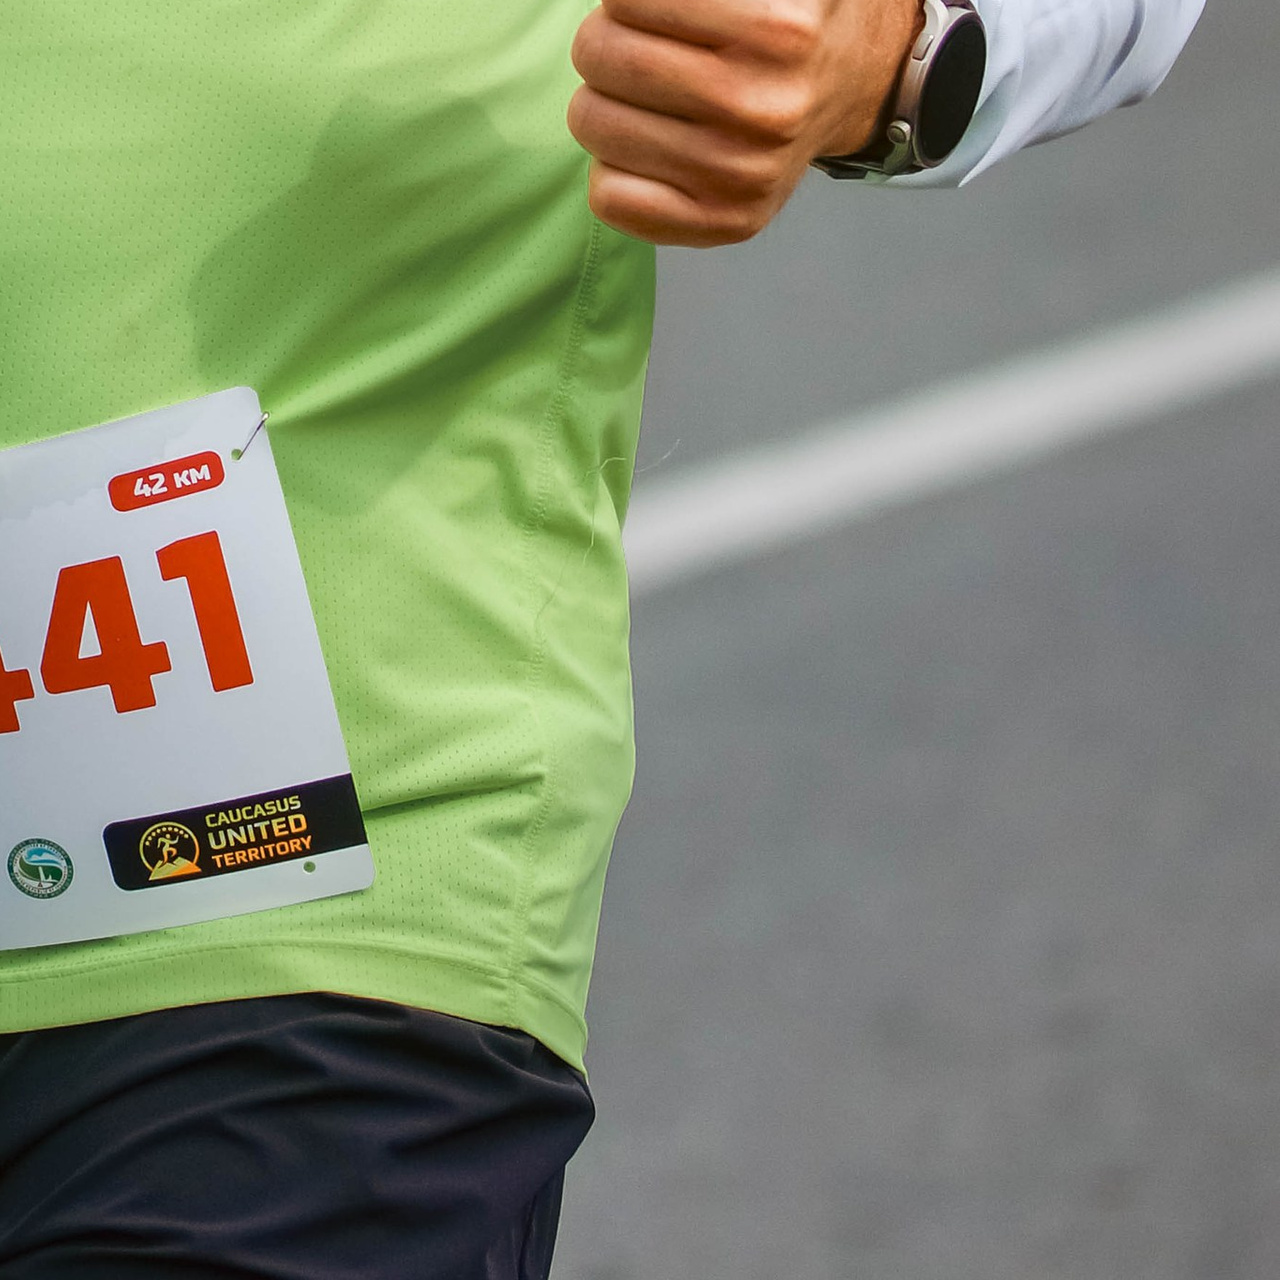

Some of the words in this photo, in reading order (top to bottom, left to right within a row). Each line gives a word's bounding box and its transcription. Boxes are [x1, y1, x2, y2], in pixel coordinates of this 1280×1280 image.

[133, 472, 168, 497] 42
[205, 795, 301, 827] CAUCASUS
[207, 813, 308, 850] UNITED
[211, 835, 312, 868] TERRITORY
